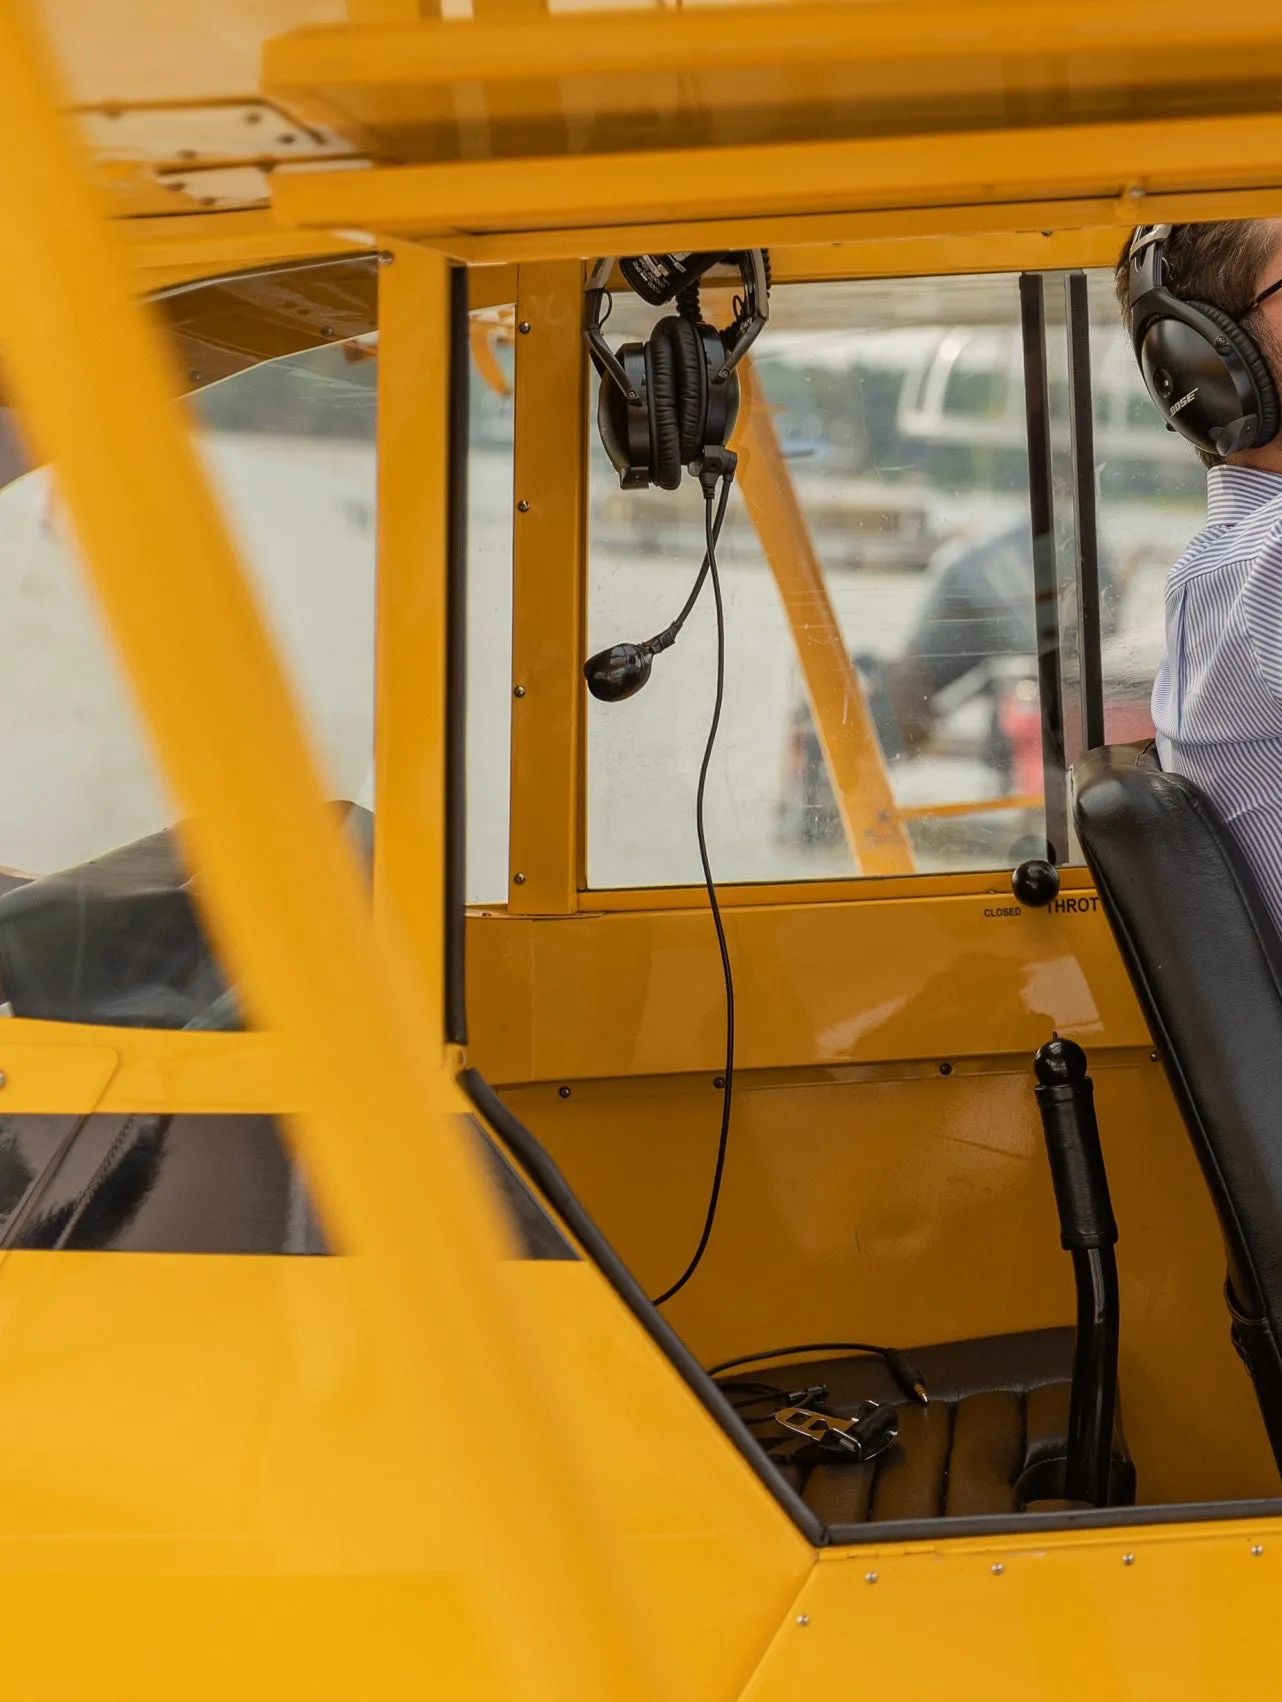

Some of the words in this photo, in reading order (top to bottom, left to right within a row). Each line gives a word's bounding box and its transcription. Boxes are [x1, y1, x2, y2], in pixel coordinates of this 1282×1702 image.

[1169, 387, 1199, 418] BOSE
[983, 906, 1022, 918] CLOSED
[1047, 896, 1099, 914] THROT
